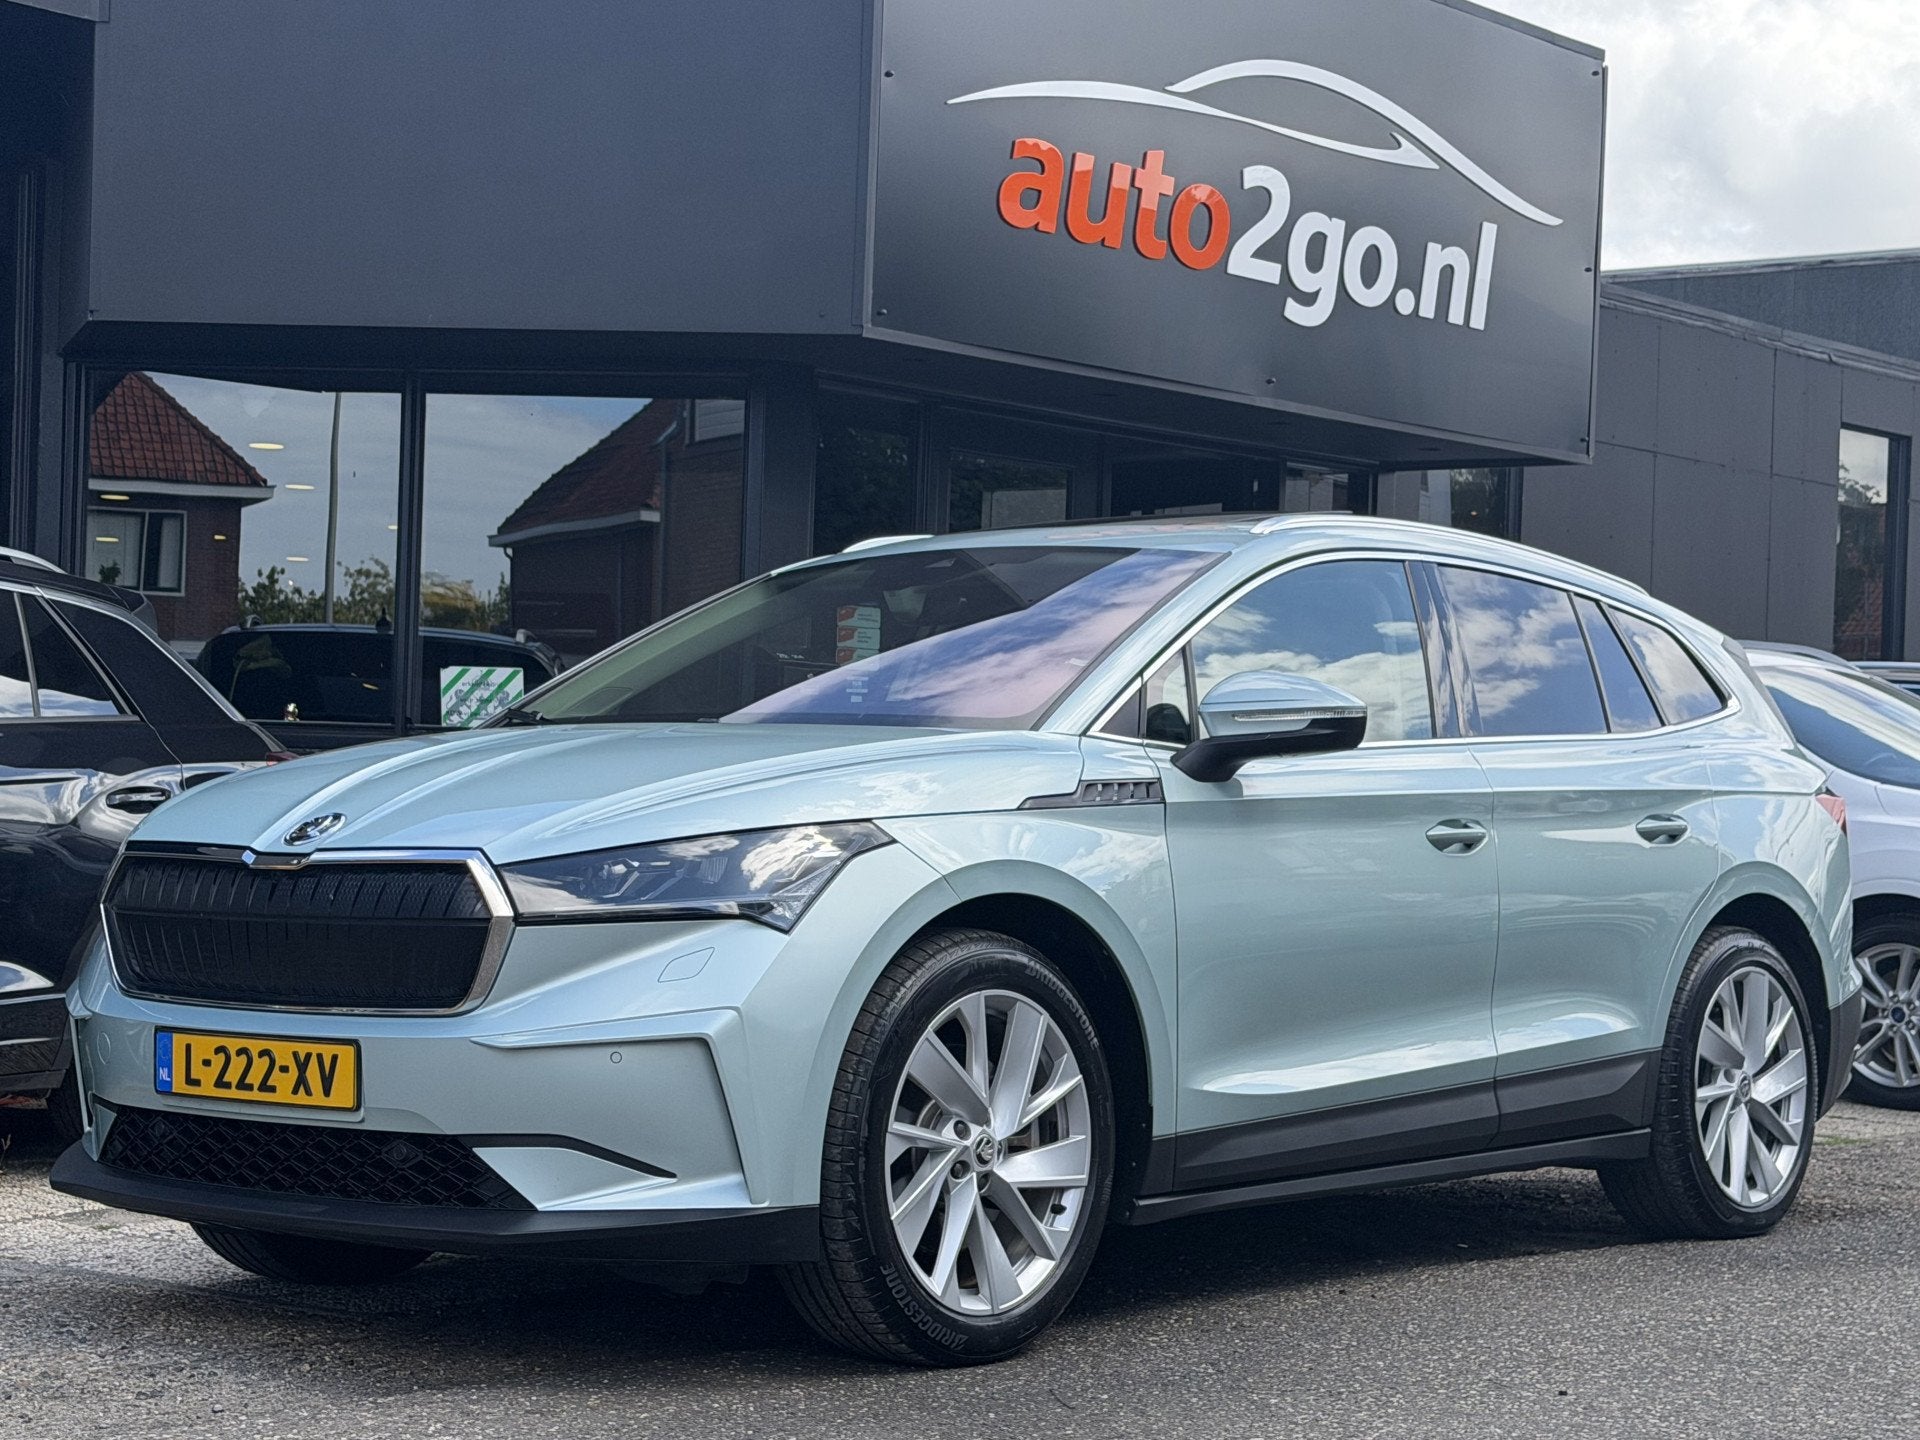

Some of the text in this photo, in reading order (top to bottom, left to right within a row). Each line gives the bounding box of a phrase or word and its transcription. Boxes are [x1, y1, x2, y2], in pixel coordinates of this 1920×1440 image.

[998, 137, 1498, 331] auto2go.nl
[1024, 960, 1101, 1051] BRIDGESTONE
[159, 1067, 171, 1082] NL
[184, 1042, 339, 1098] L-222-XV
[880, 1262, 969, 1351] BRIDGESTONE
